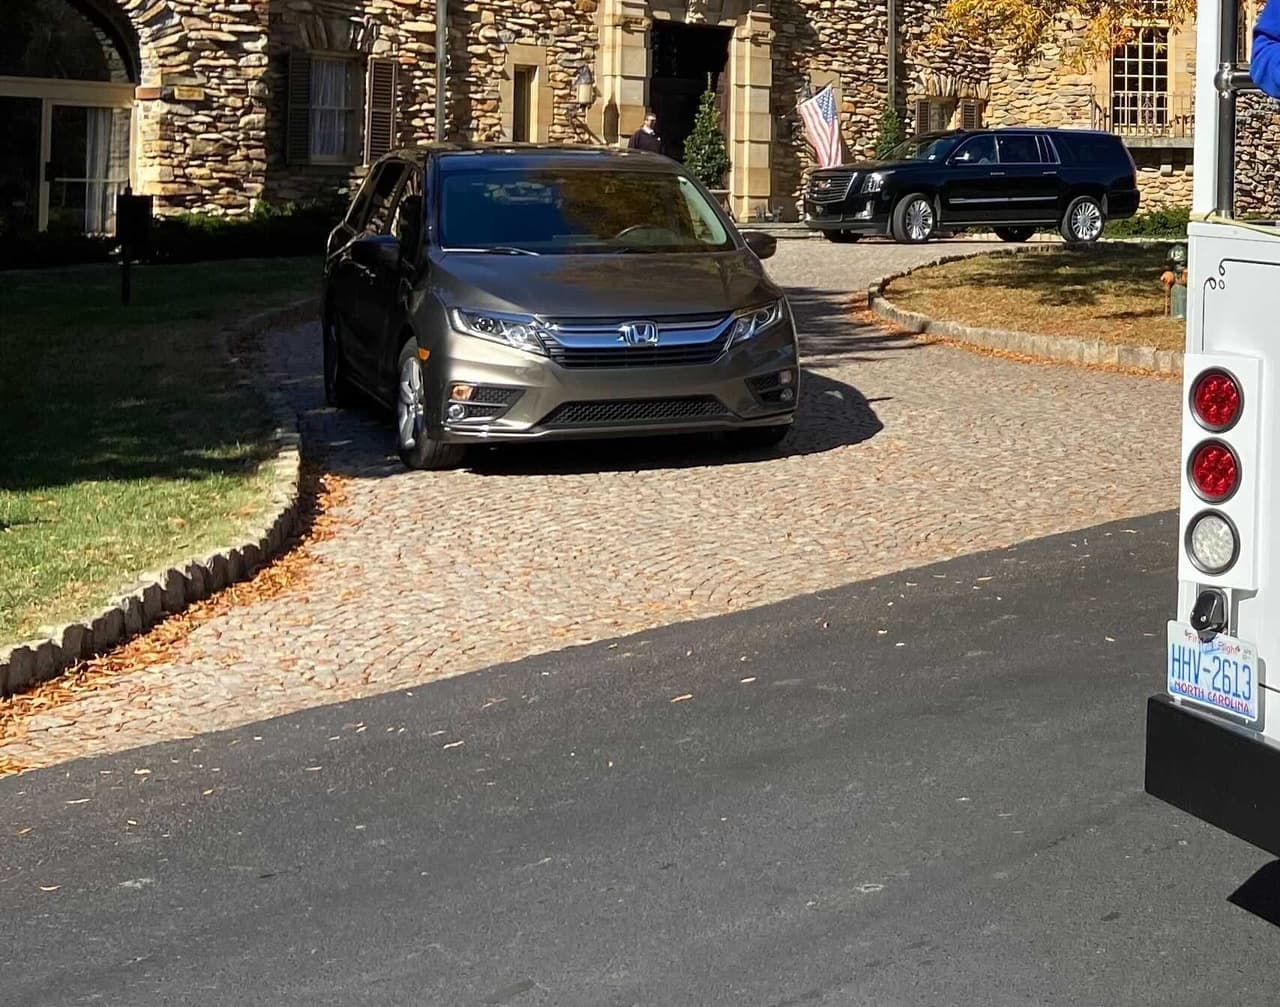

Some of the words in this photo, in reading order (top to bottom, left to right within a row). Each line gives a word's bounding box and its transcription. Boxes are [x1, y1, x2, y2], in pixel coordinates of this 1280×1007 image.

[1171, 643, 1252, 701] HHV-2613
[1174, 680, 1205, 700] NORTH
[1207, 692, 1249, 713] CAROLINA
